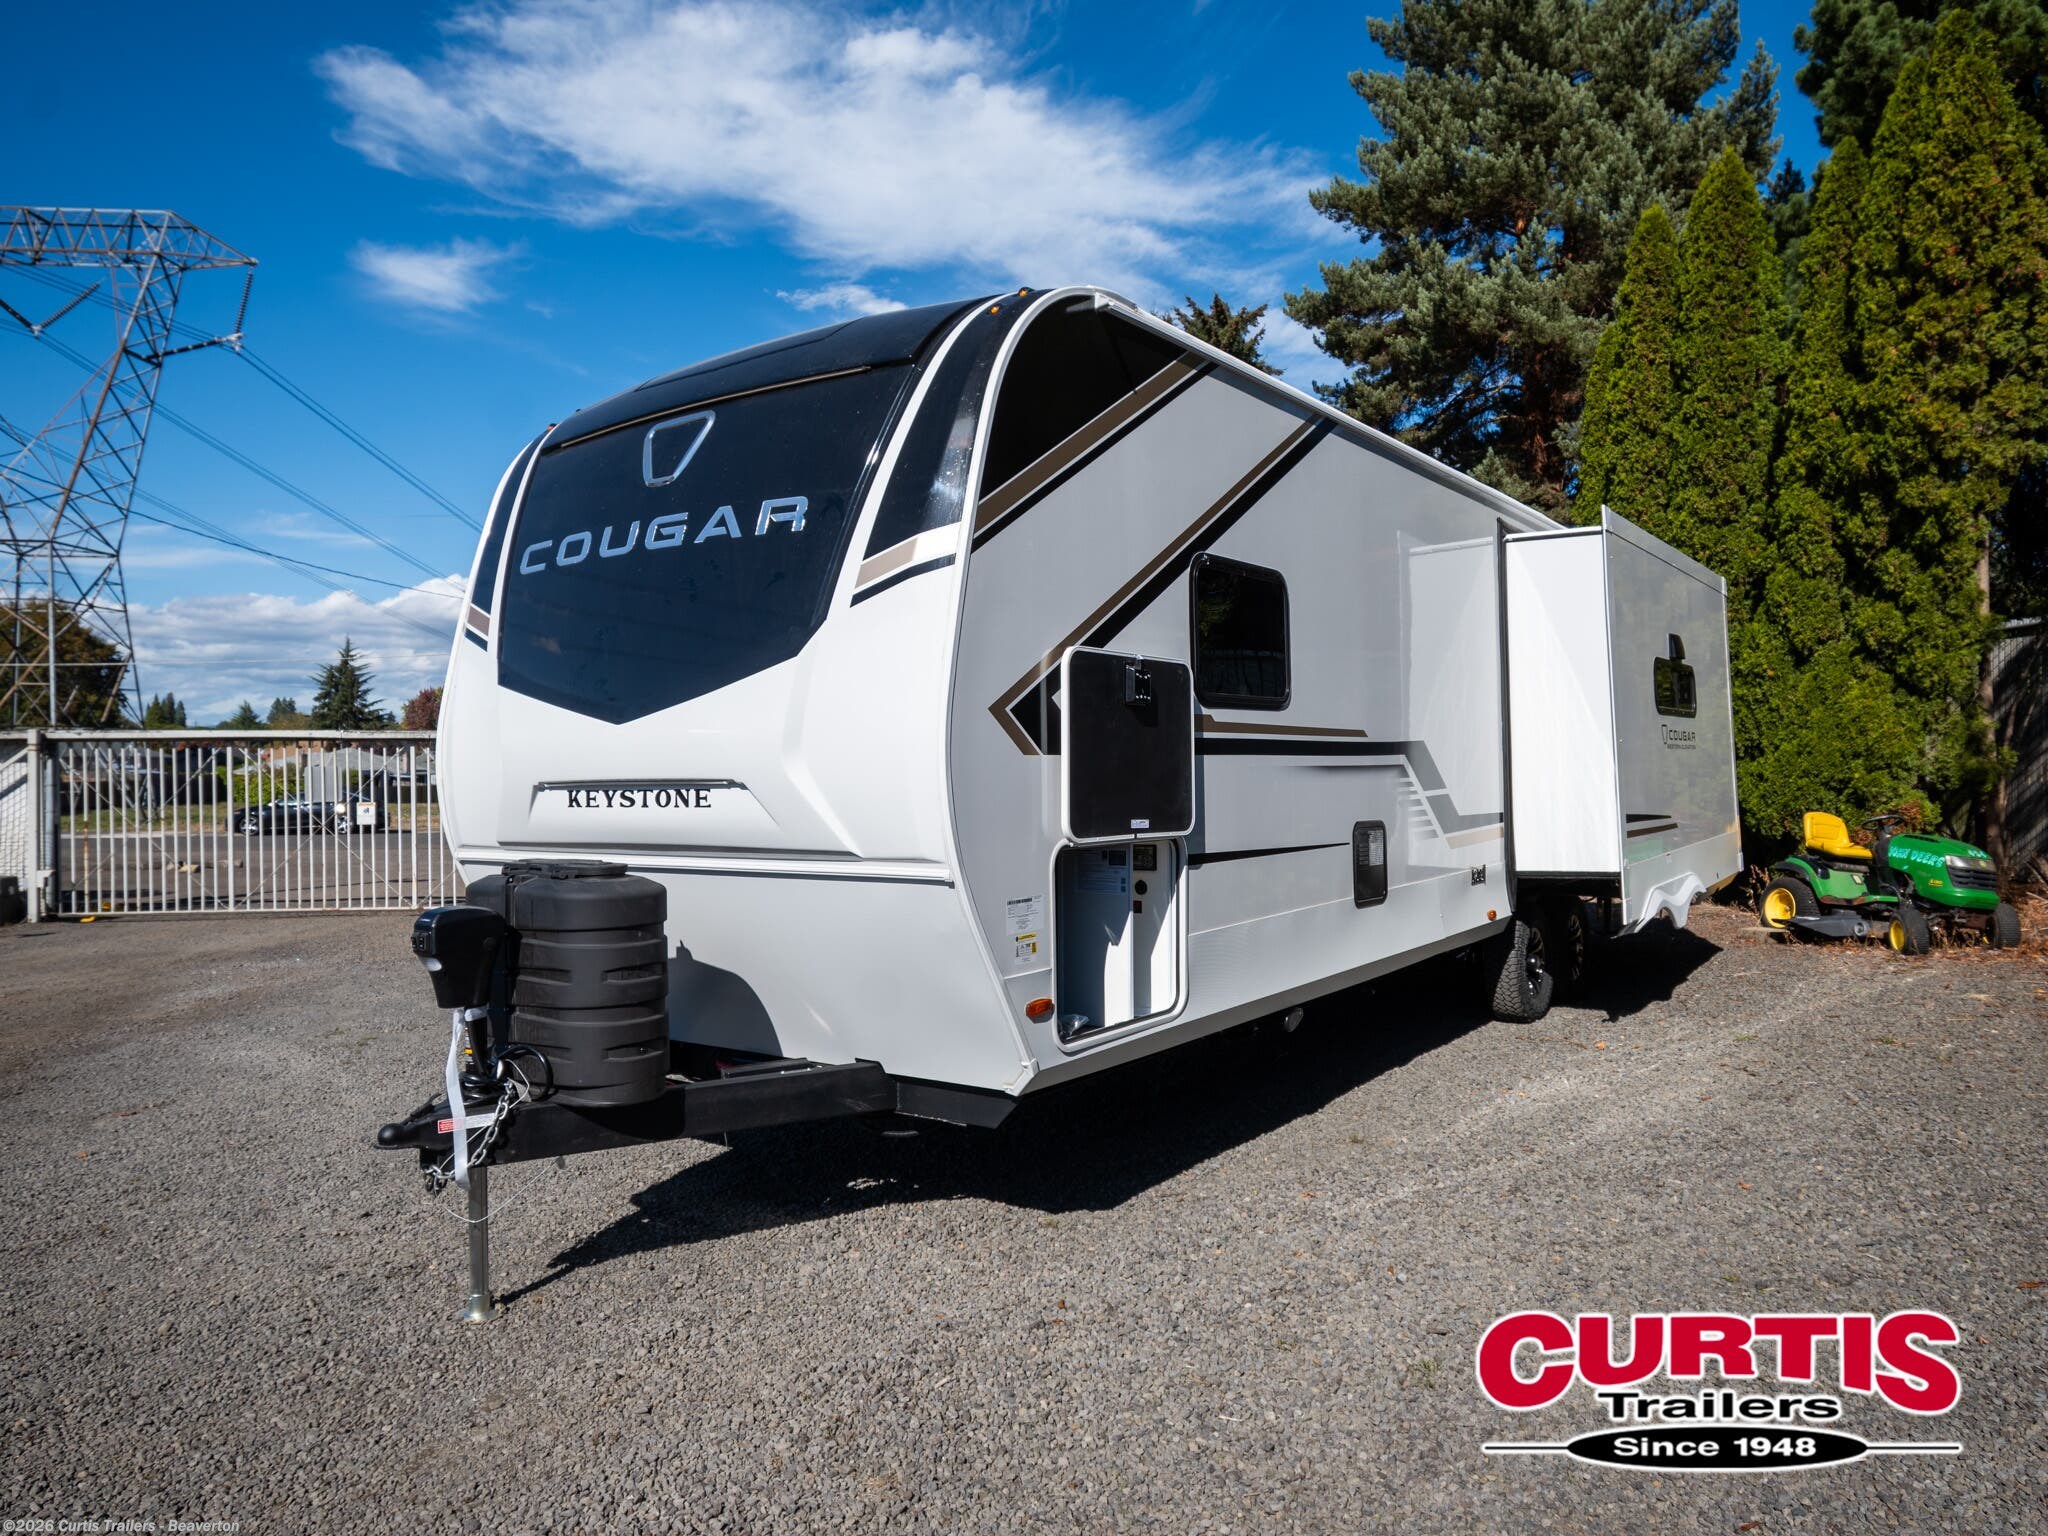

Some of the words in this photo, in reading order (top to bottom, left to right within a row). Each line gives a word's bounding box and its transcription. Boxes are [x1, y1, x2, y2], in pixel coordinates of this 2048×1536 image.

[520, 495, 808, 575] COUGAR
[1669, 729, 1696, 741] COUGAR
[567, 788, 711, 808] KEYSTONE
